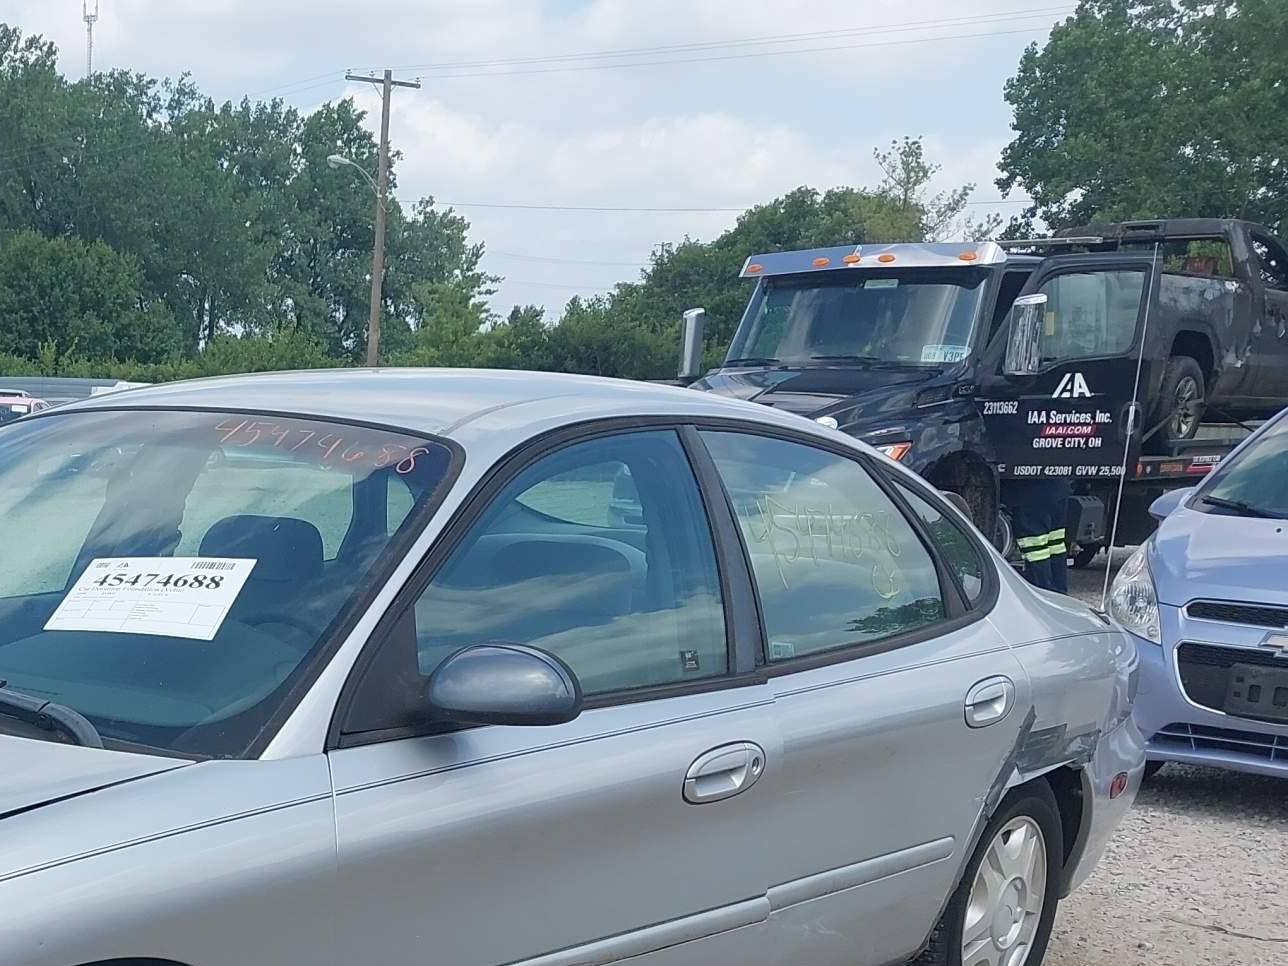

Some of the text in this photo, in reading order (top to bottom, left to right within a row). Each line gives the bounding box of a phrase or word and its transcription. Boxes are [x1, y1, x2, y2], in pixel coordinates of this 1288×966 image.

[983, 401, 1019, 415] 23113662
[1027, 409, 1113, 424] IAA Services, Inc.
[1045, 425, 1092, 435] IAAI.COM
[1032, 437, 1103, 449] GROVE CITY, OH
[1013, 465, 1043, 476] USDOT
[1044, 465, 1073, 476] 423081
[1075, 465, 1099, 476] GVW
[1099, 466, 1125, 477] 25,500
[93, 573, 224, 590] 45474688
